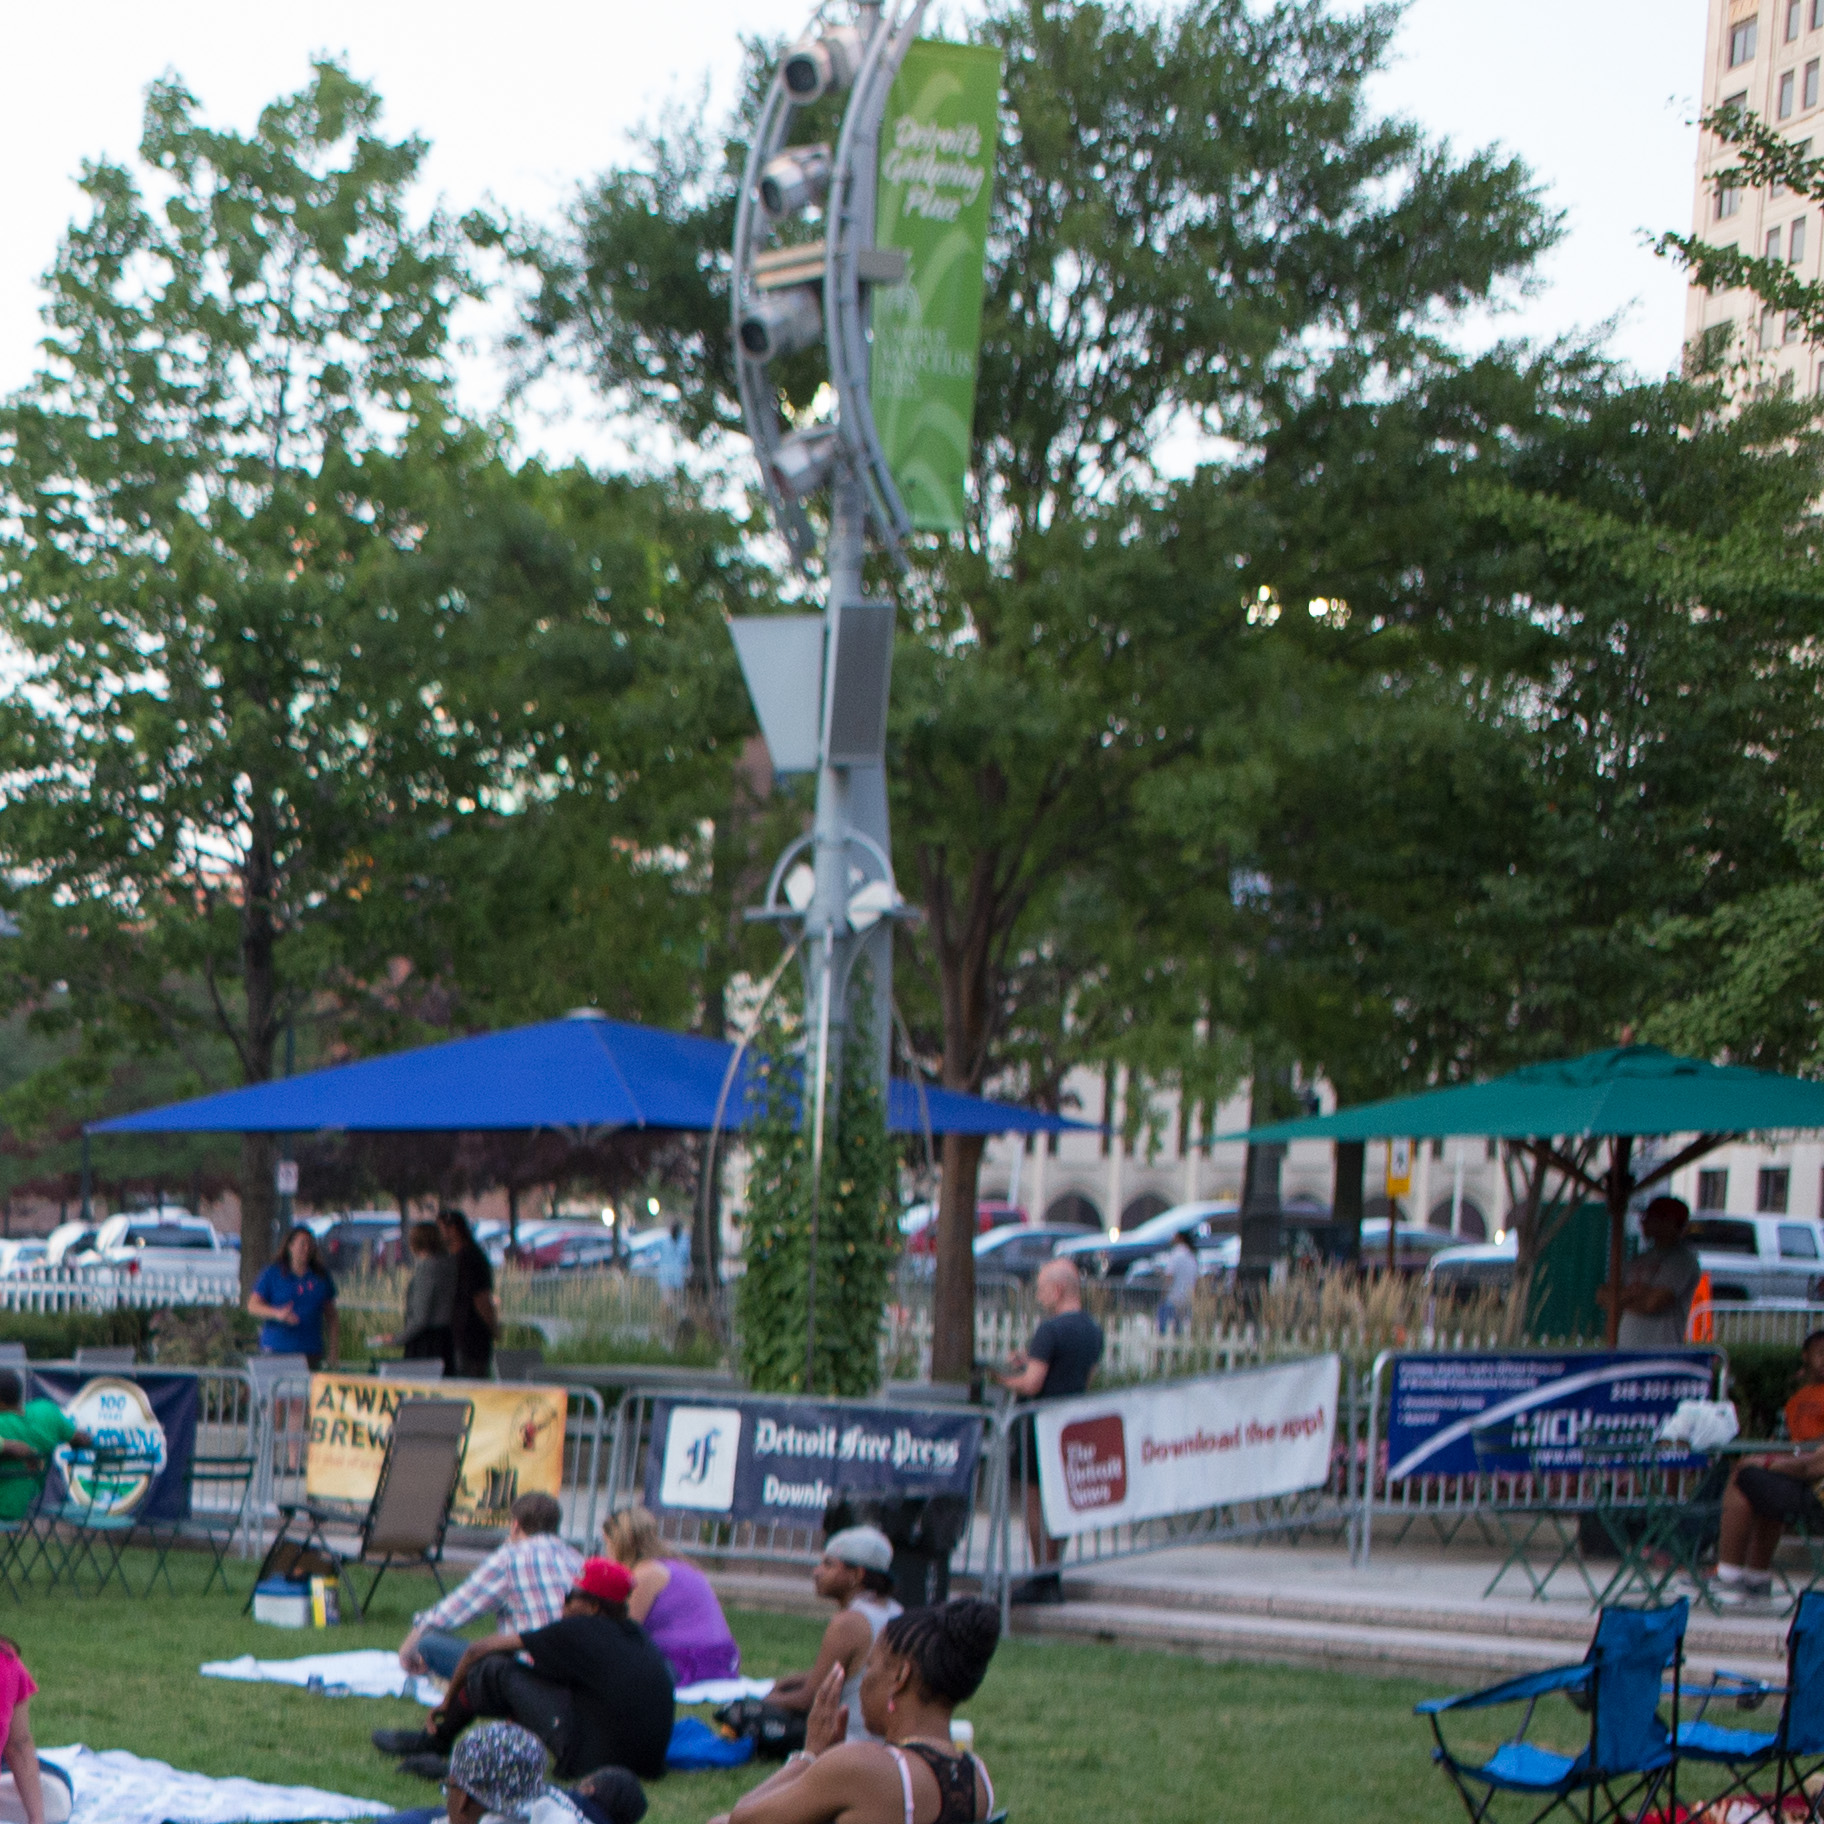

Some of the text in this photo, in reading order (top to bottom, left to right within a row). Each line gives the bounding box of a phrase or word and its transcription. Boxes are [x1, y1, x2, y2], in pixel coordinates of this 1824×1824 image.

[756, 1416, 960, 1470] Detroit Free Press
[1140, 1404, 1324, 1466] Download the app!
